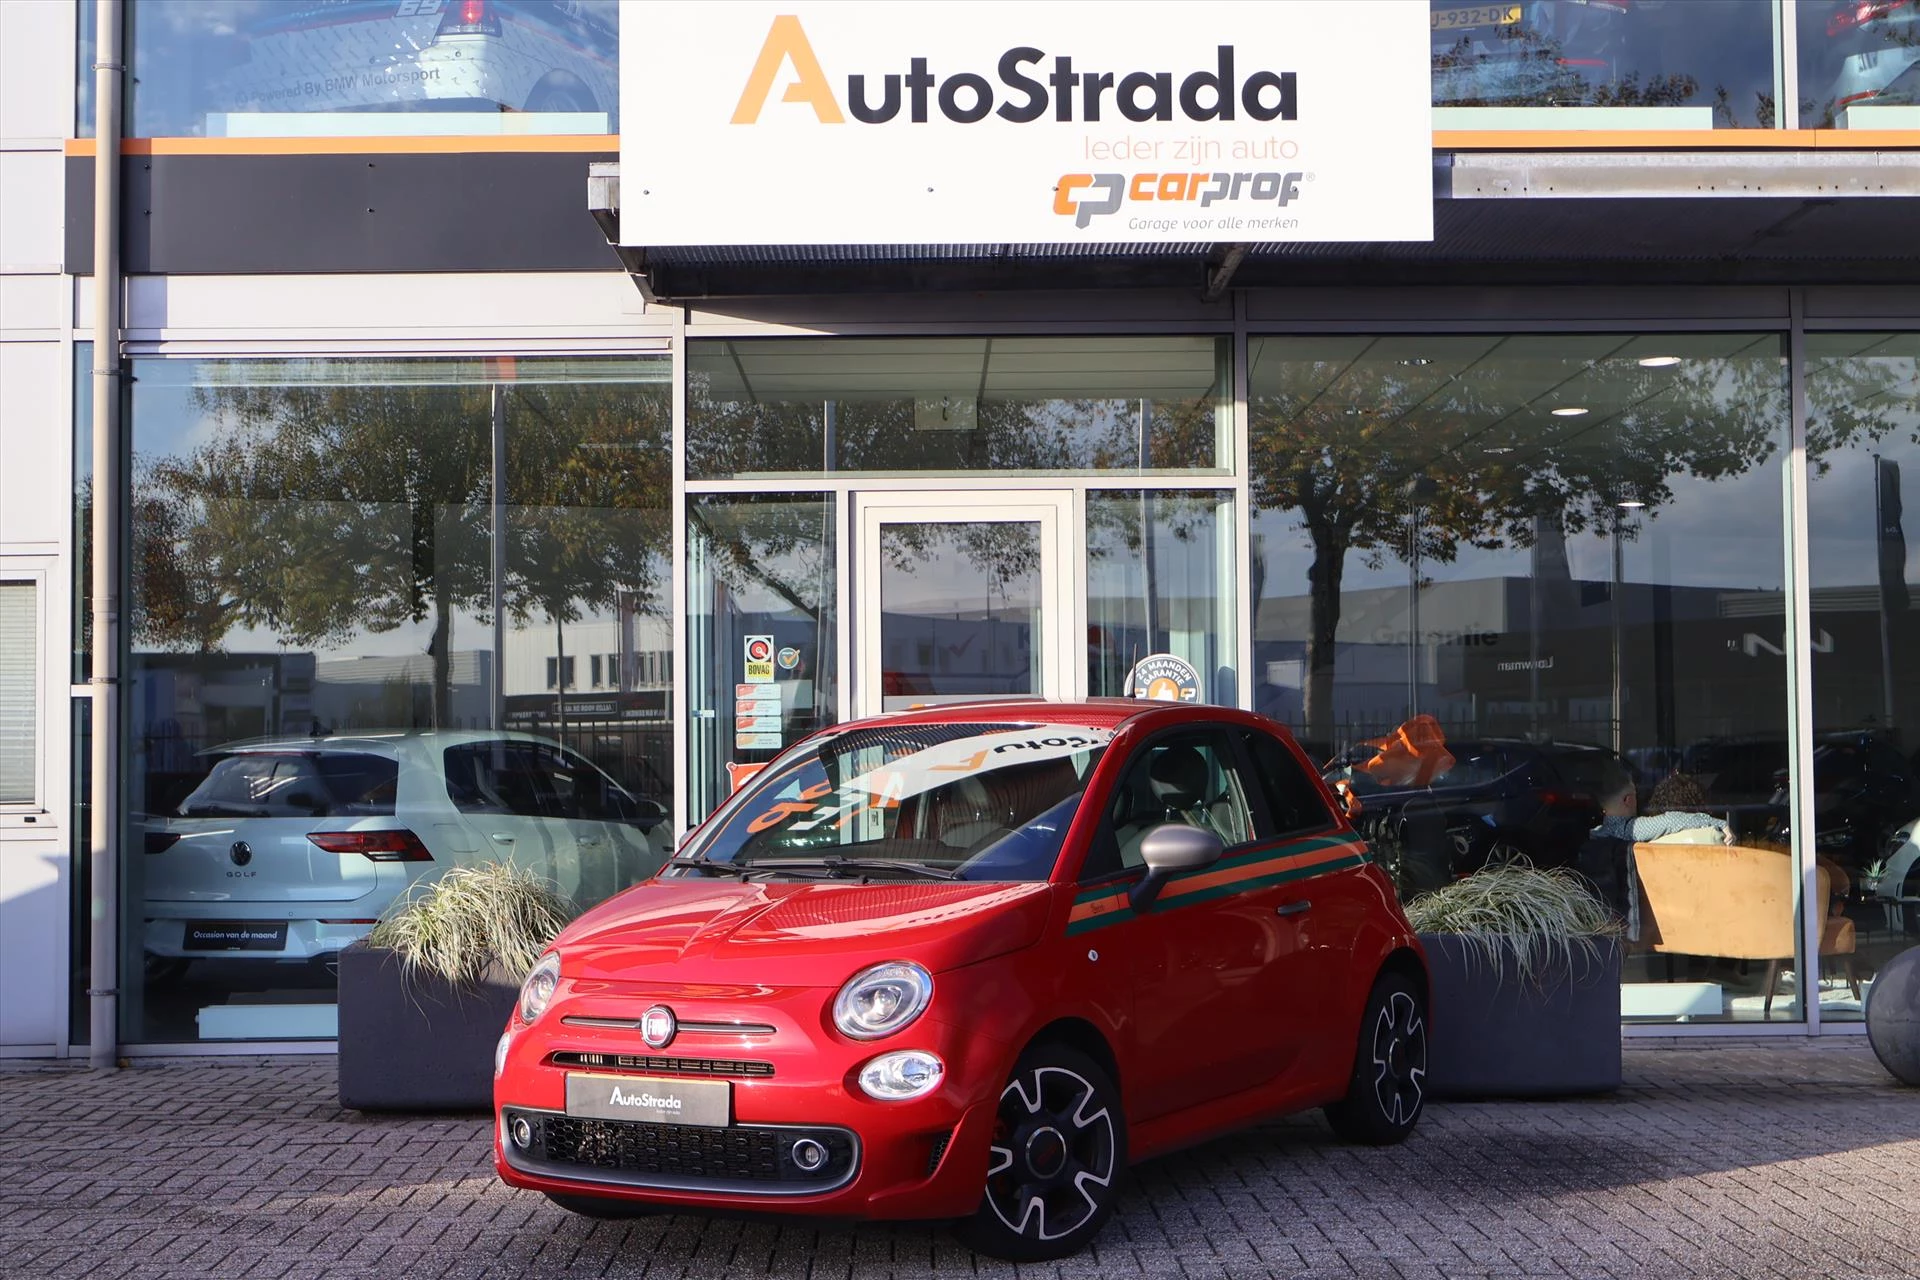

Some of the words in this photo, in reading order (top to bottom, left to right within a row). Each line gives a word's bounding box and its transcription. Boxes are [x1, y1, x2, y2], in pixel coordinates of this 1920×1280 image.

[729, 14, 1298, 124] AutoStrada
[304, 82, 321, 96] By
[325, 75, 358, 92] BMW
[362, 67, 441, 87] Motorsport
[1085, 135, 1164, 160] Ieder
[1173, 136, 1221, 166] zijn
[1231, 136, 1299, 160] auto
[1129, 172, 1303, 207] carprof
[1129, 217, 1178, 232] Garage
[1183, 220, 1213, 230] voor
[1218, 217, 1244, 230] alle
[1248, 217, 1299, 229] merken
[748, 664, 770, 675] BOVAG
[1136, 668, 1148, 681] 24
[1147, 660, 1192, 681] MAANDEN
[1143, 669, 1185, 686] GARANTIE
[193, 931, 225, 939] Occasion
[240, 931, 250, 939] de
[251, 931, 278, 939] maand
[609, 1086, 681, 1109] AutoStrada
